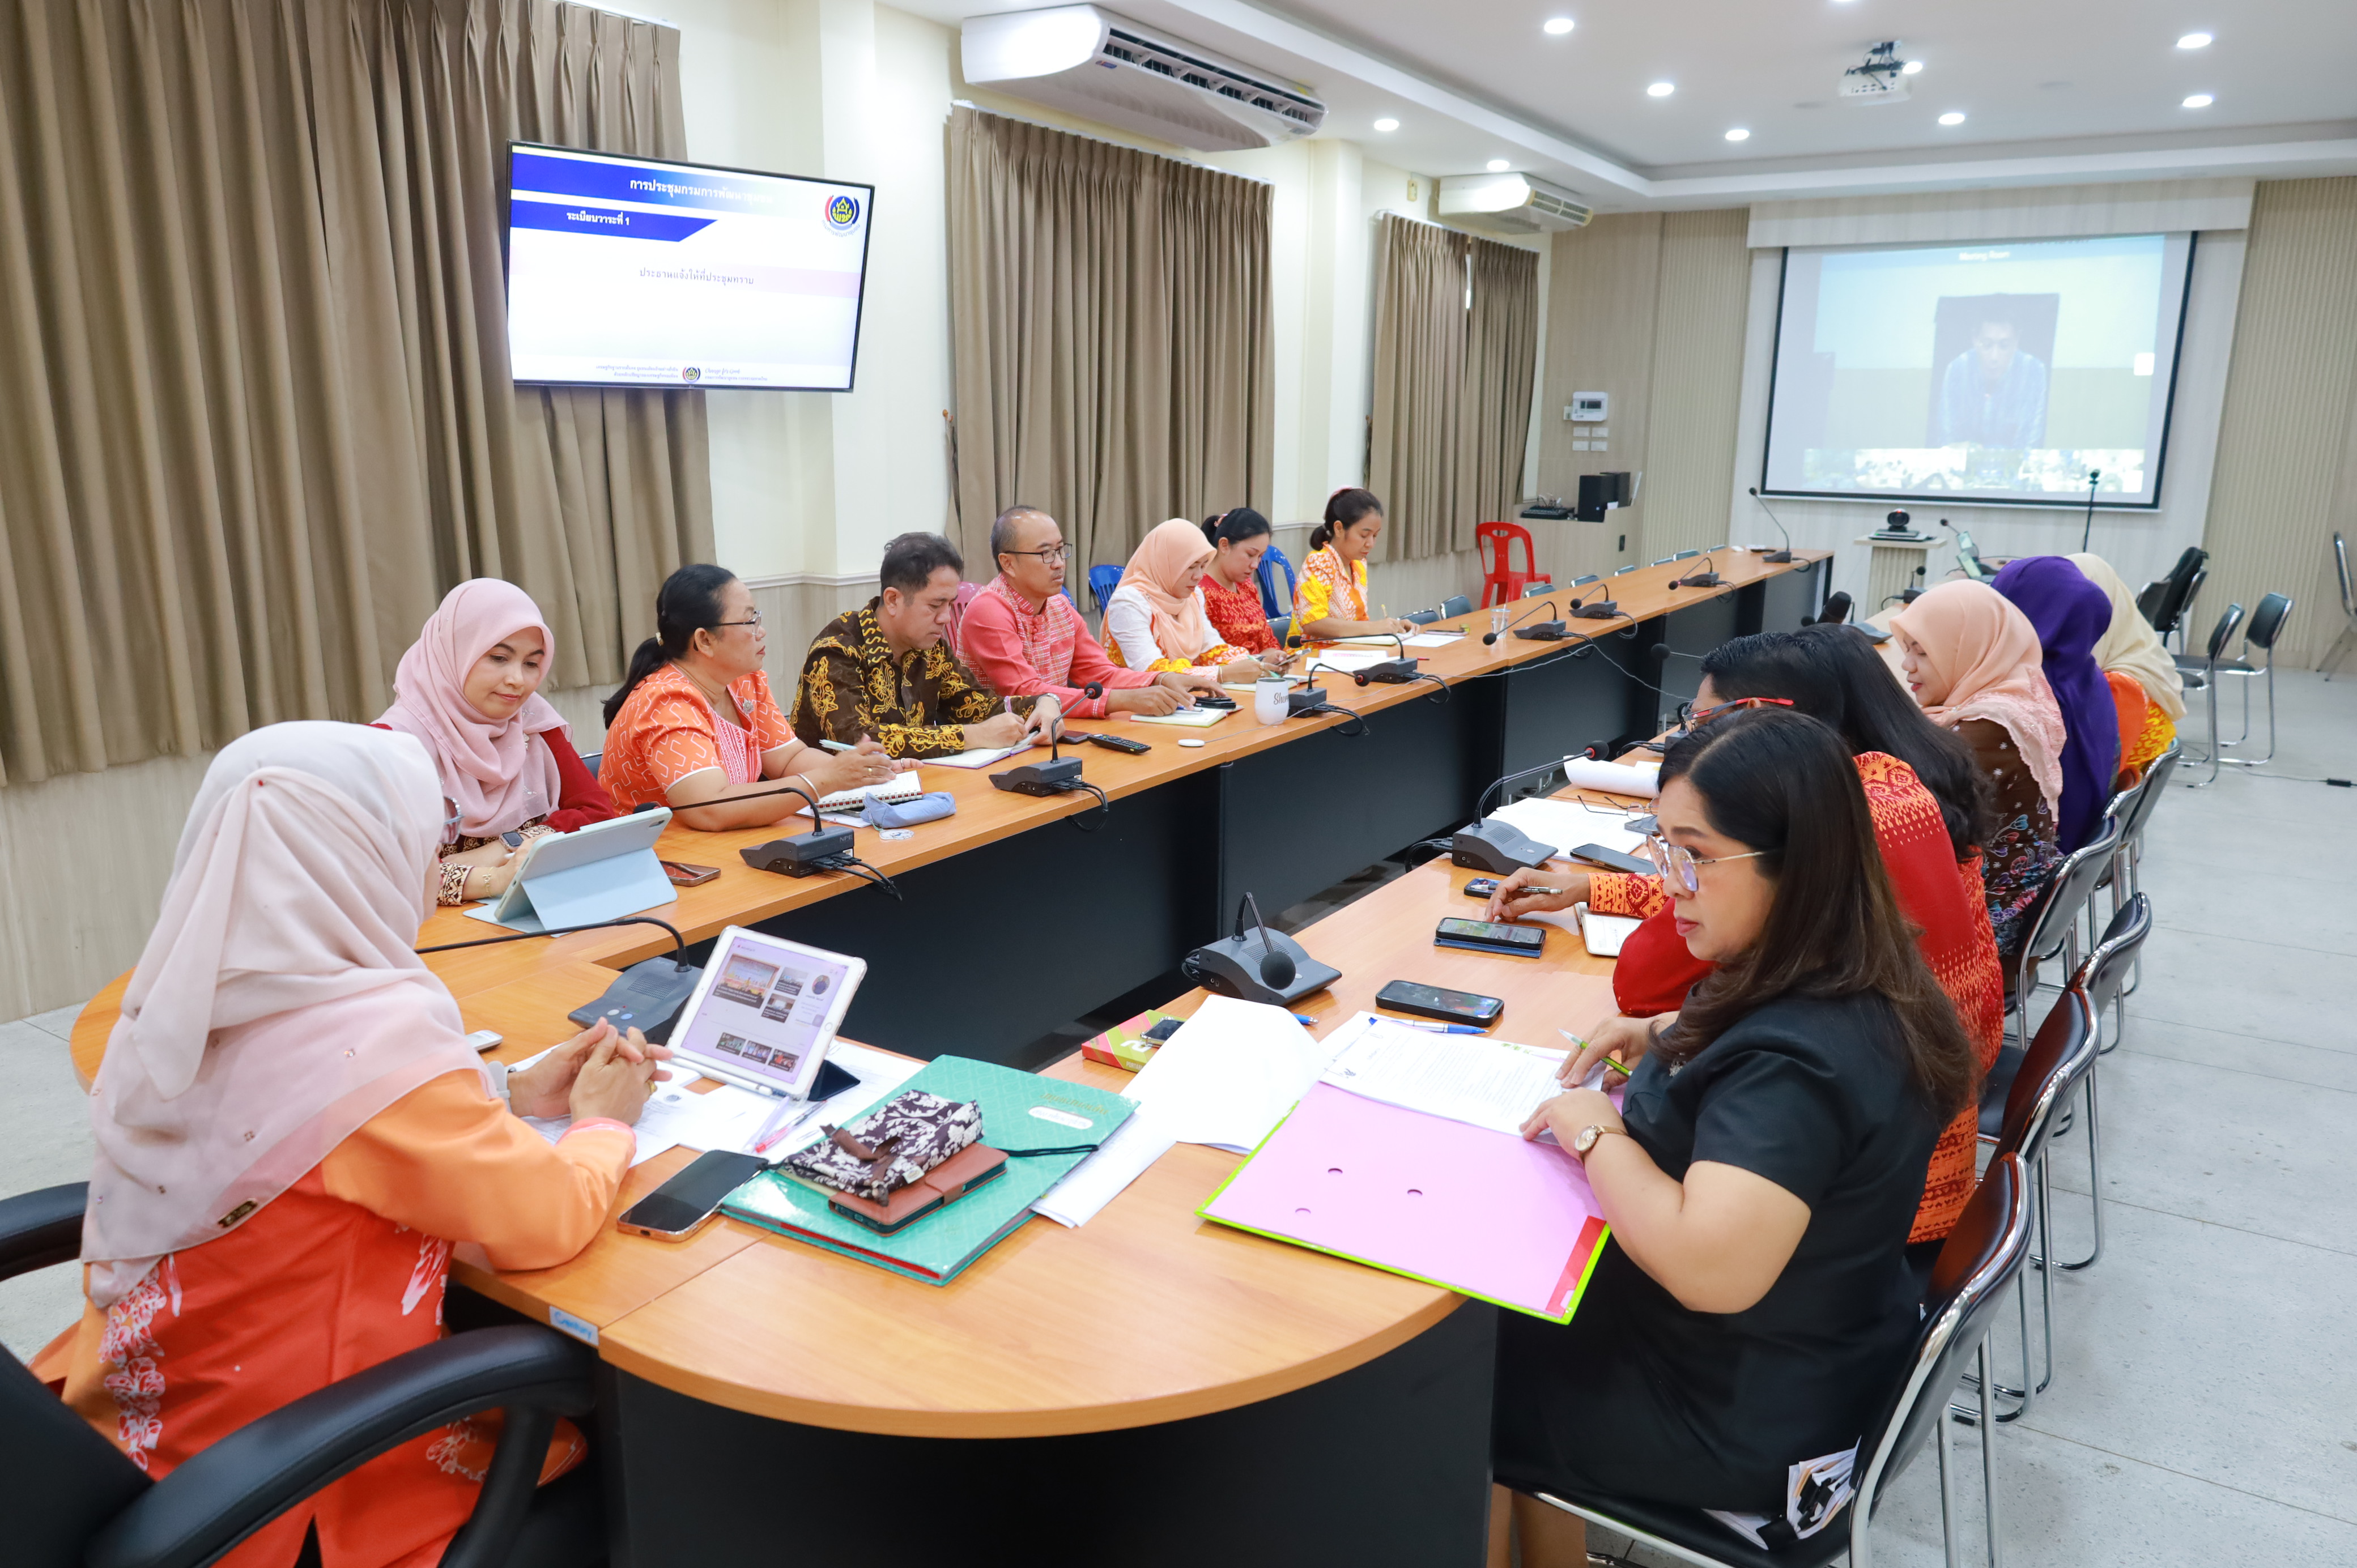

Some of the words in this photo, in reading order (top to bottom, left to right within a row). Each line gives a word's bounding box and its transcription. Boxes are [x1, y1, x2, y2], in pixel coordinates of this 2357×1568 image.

[567, 210, 623, 225] ระเบียบวาระที่
[625, 217, 630, 226] 1
[839, 834, 853, 842] NPE
